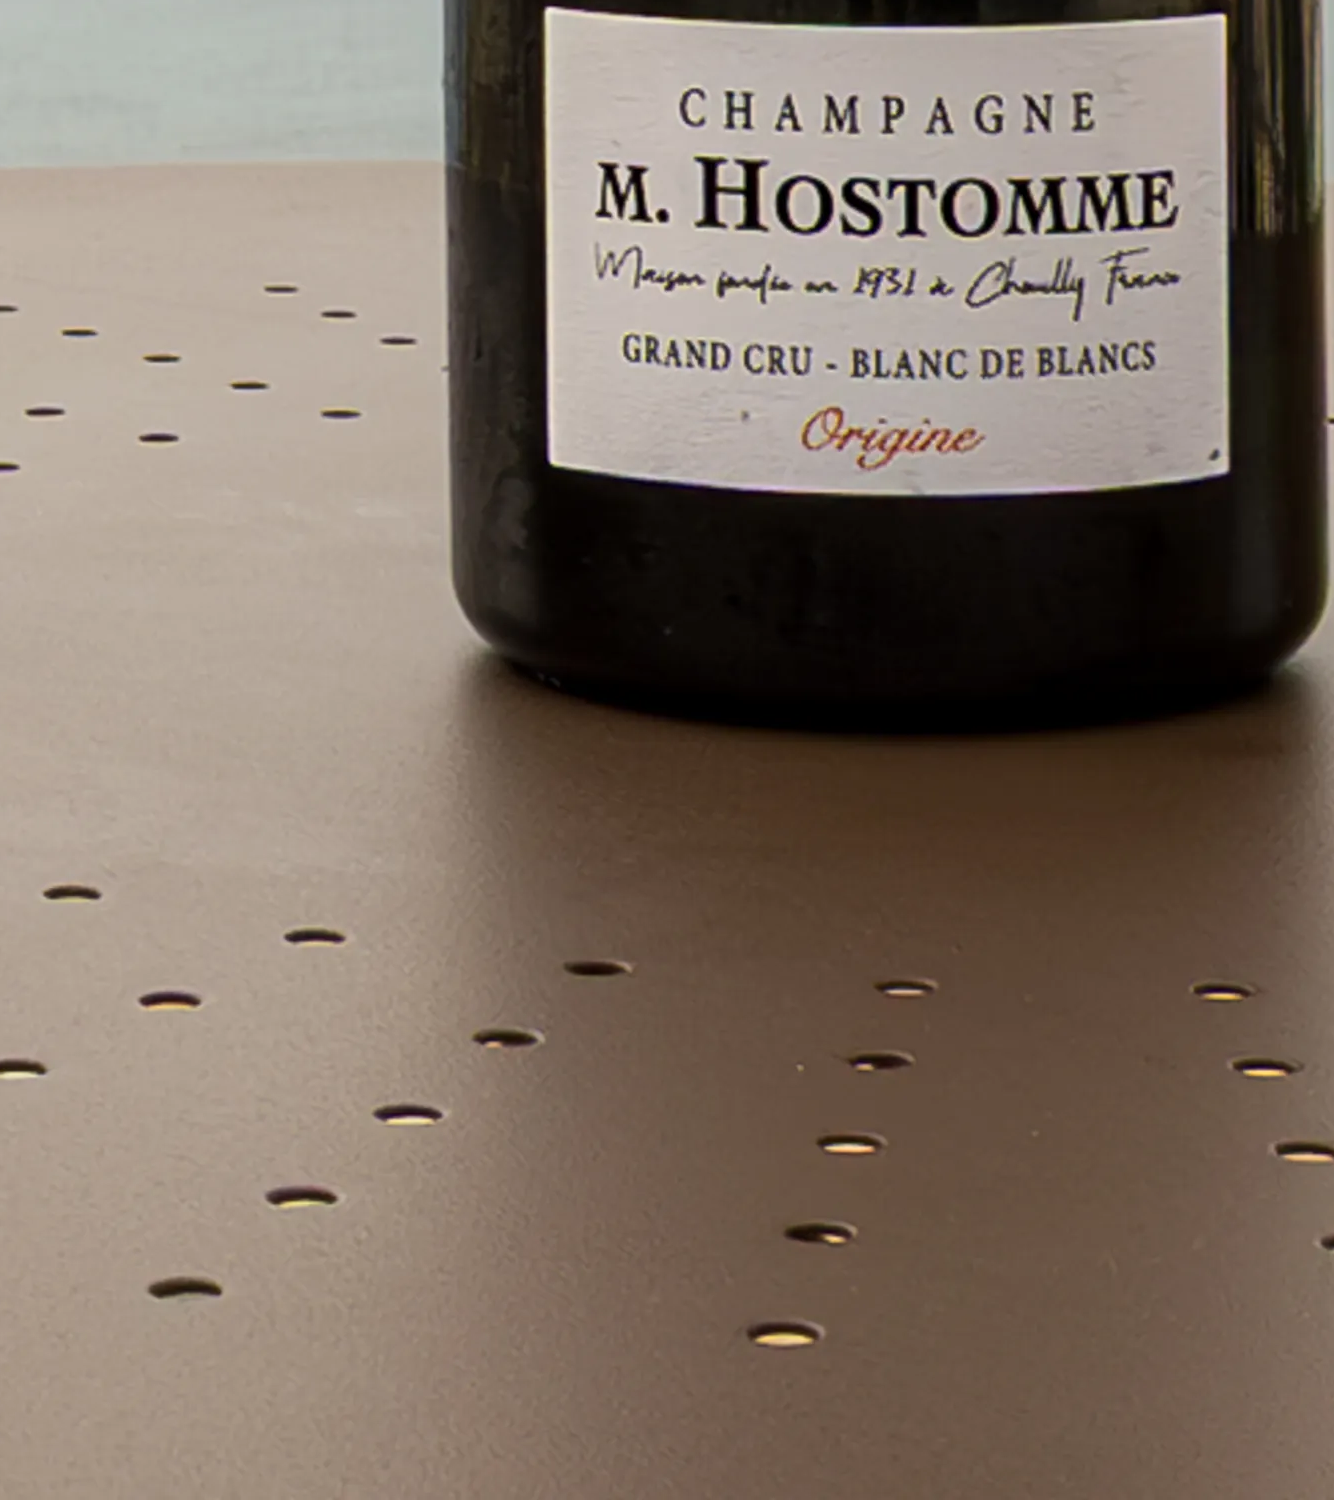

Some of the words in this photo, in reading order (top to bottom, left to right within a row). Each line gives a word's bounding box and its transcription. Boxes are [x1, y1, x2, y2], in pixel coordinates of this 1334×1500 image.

[679, 87, 1096, 135] CHAMPAGNE
[595, 161, 671, 224] M.
[693, 155, 1180, 239] HOSTOMME
[852, 266, 917, 299] 1931
[622, 332, 732, 371] GRAND
[743, 343, 813, 376] CRU
[850, 347, 970, 381] BLANC
[980, 347, 1025, 380] DE
[1036, 339, 1157, 378] BLANCS
[801, 405, 986, 470] Origine
